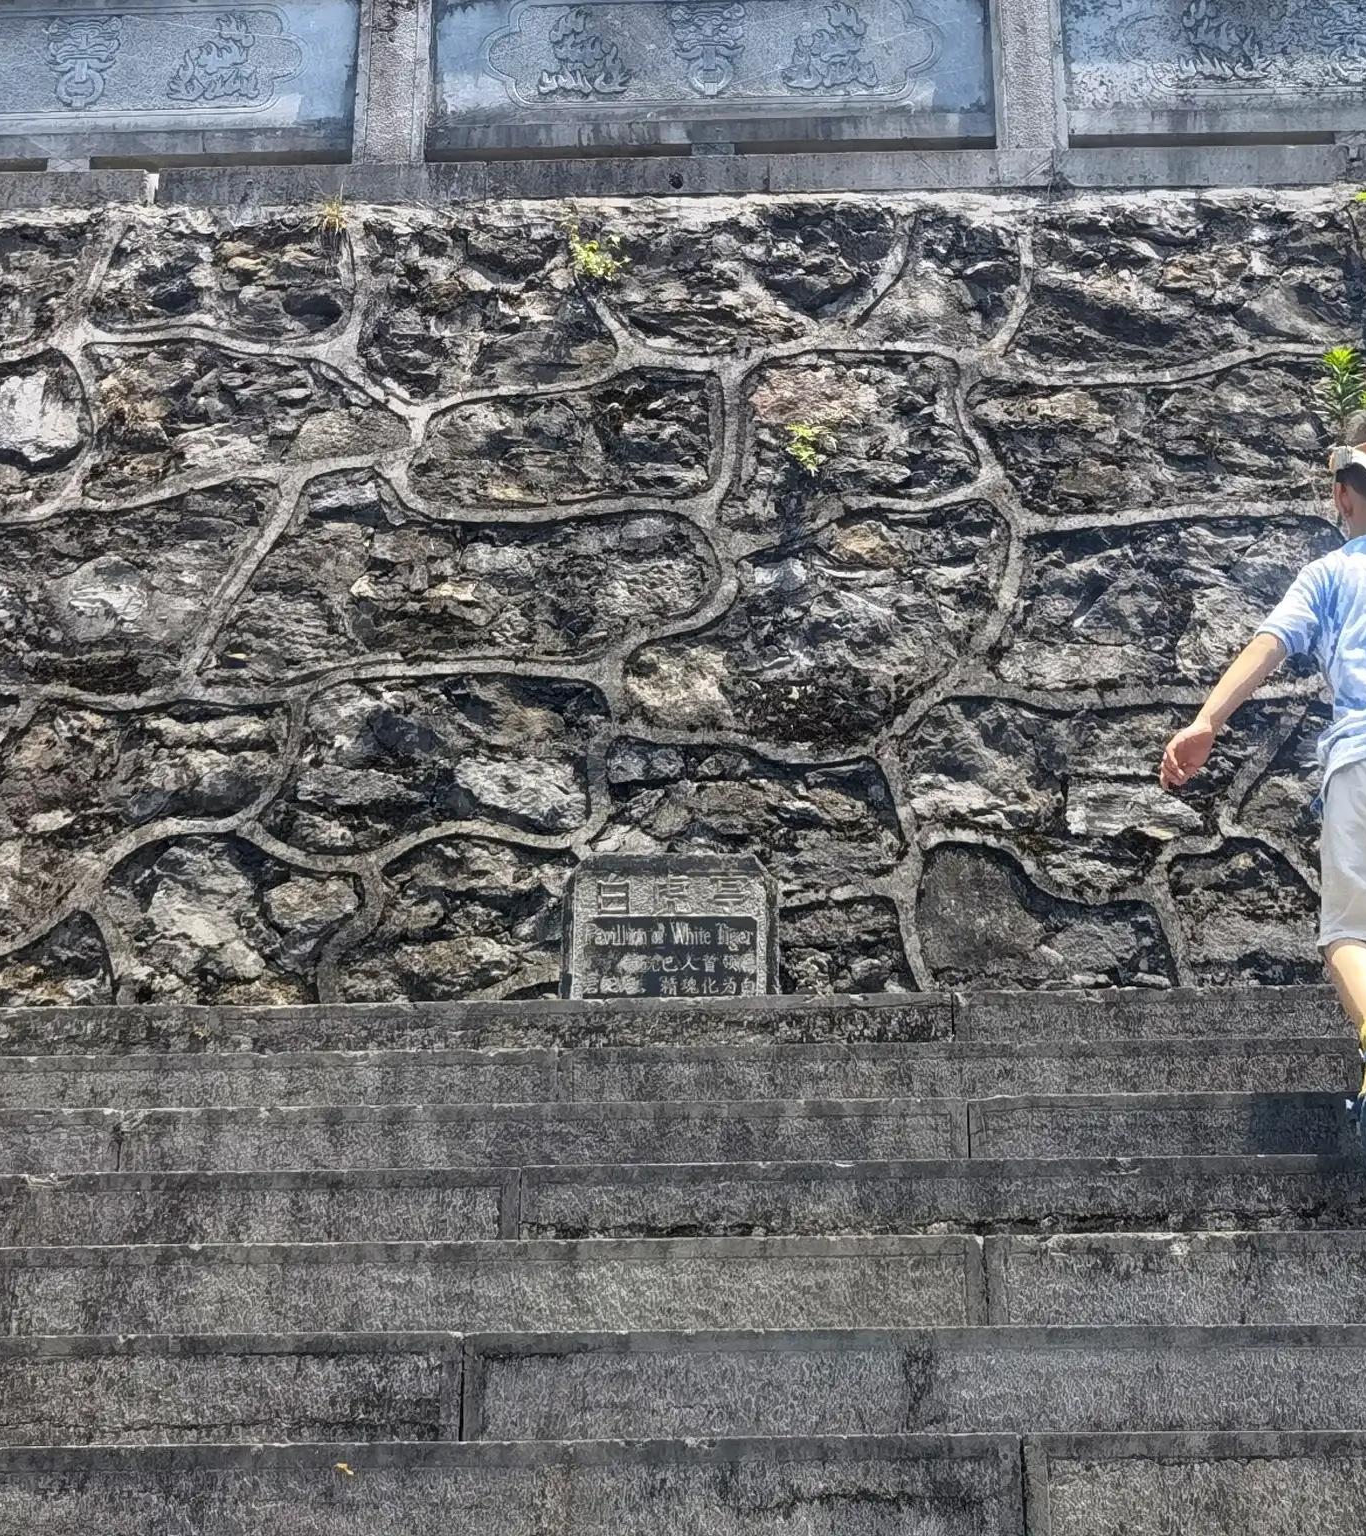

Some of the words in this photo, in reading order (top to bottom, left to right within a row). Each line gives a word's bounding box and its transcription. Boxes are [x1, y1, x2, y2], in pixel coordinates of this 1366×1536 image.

[651, 922, 667, 946] of
[670, 921, 712, 946] White
[715, 922, 754, 952] Tiger
